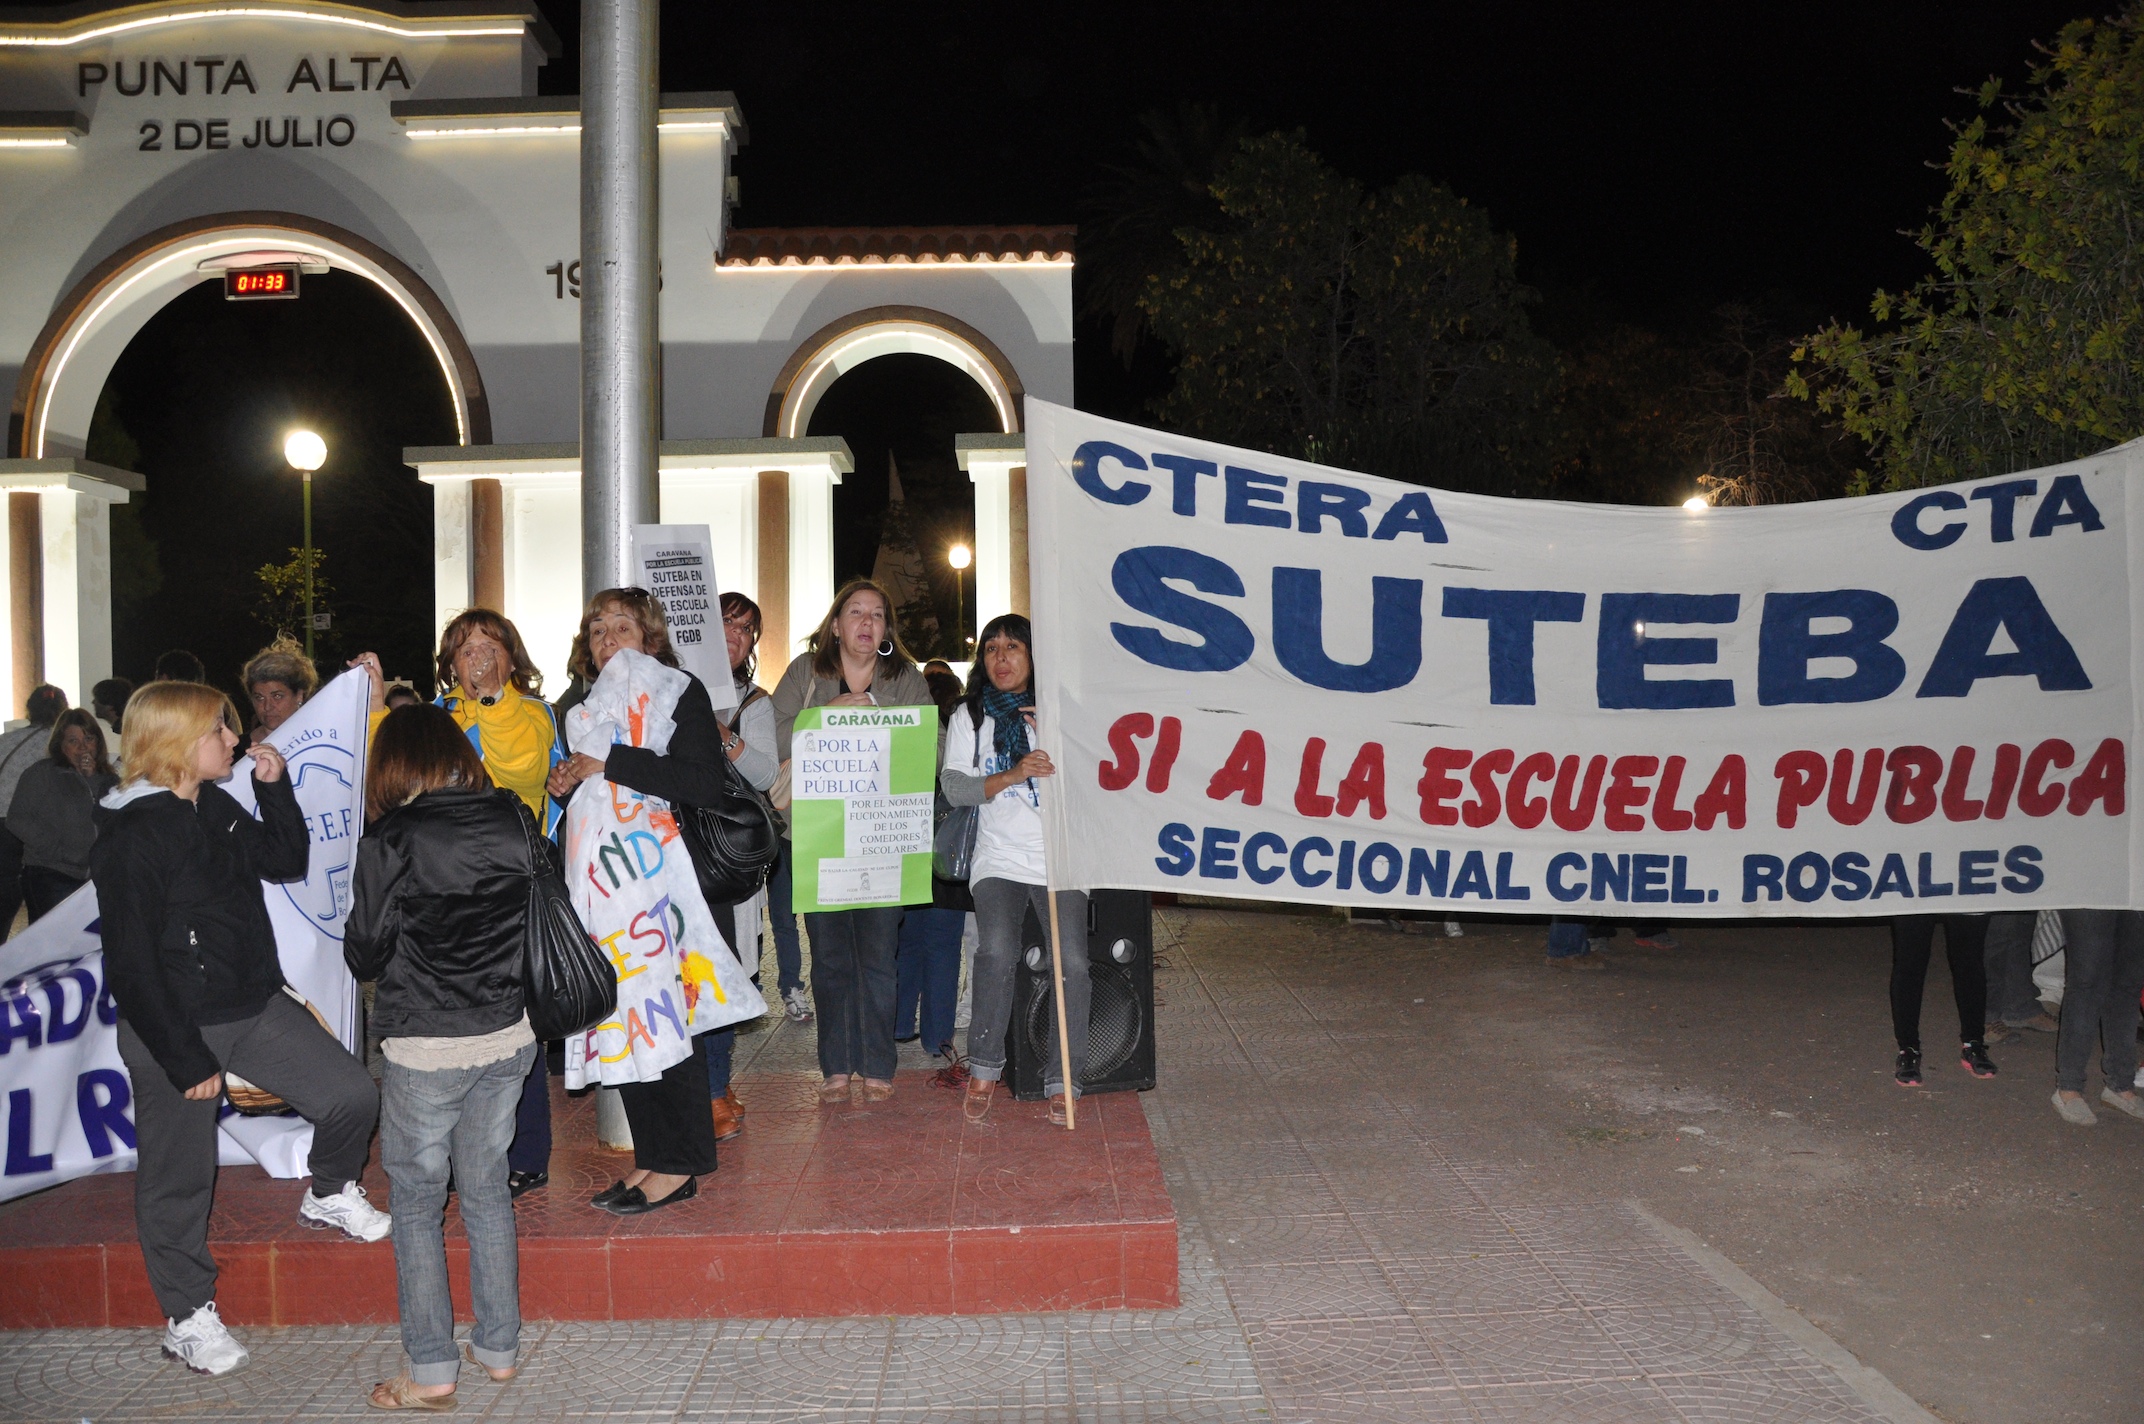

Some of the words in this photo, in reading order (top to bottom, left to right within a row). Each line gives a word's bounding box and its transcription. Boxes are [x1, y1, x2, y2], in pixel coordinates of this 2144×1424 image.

[78, 60, 256, 97] PUNTA
[287, 56, 411, 93] ALTA
[139, 123, 162, 151] 2
[174, 121, 230, 150] DE
[243, 117, 355, 149] JULIO
[237, 274, 284, 292] 01:33
[1072, 441, 1448, 543] CTERA
[1891, 475, 2105, 550] CTA
[656, 550, 692, 558] CARAVANA
[652, 571, 689, 583] SUTEBA
[691, 570, 702, 581] EN
[651, 585, 694, 598] DEFENSA
[696, 584, 707, 596] DE
[670, 599, 709, 611] ESCUELA
[666, 612, 705, 627] PÚBLICA
[1110, 545, 2093, 710] SUTEBA
[676, 629, 701, 644] FGDB
[827, 714, 915, 726] CARAVANA
[329, 728, 338, 740] a
[818, 740, 851, 753] POR
[857, 739, 879, 752] LA
[802, 759, 880, 773] ESCUELA
[1098, 713, 1181, 793] SI
[1206, 730, 1266, 806] A
[1294, 737, 1386, 820] LA
[1417, 747, 1746, 832] ESCUELA
[1774, 739, 2125, 829] PUBLICA
[804, 776, 878, 793] PÚBLICA
[851, 800, 871, 809] POR
[874, 799, 886, 808] EL
[888, 798, 930, 807] NORMAL
[849, 808, 932, 820] FUCIONAMIENTO
[874, 822, 887, 831] DE
[889, 822, 908, 830] LOS
[859, 832, 921, 844] COMEDORES
[862, 844, 918, 855] ESCOLARES
[1154, 823, 1530, 900] SECCIONAL
[1546, 851, 1718, 903] CNEL.
[1742, 845, 2044, 903] ROSALES
